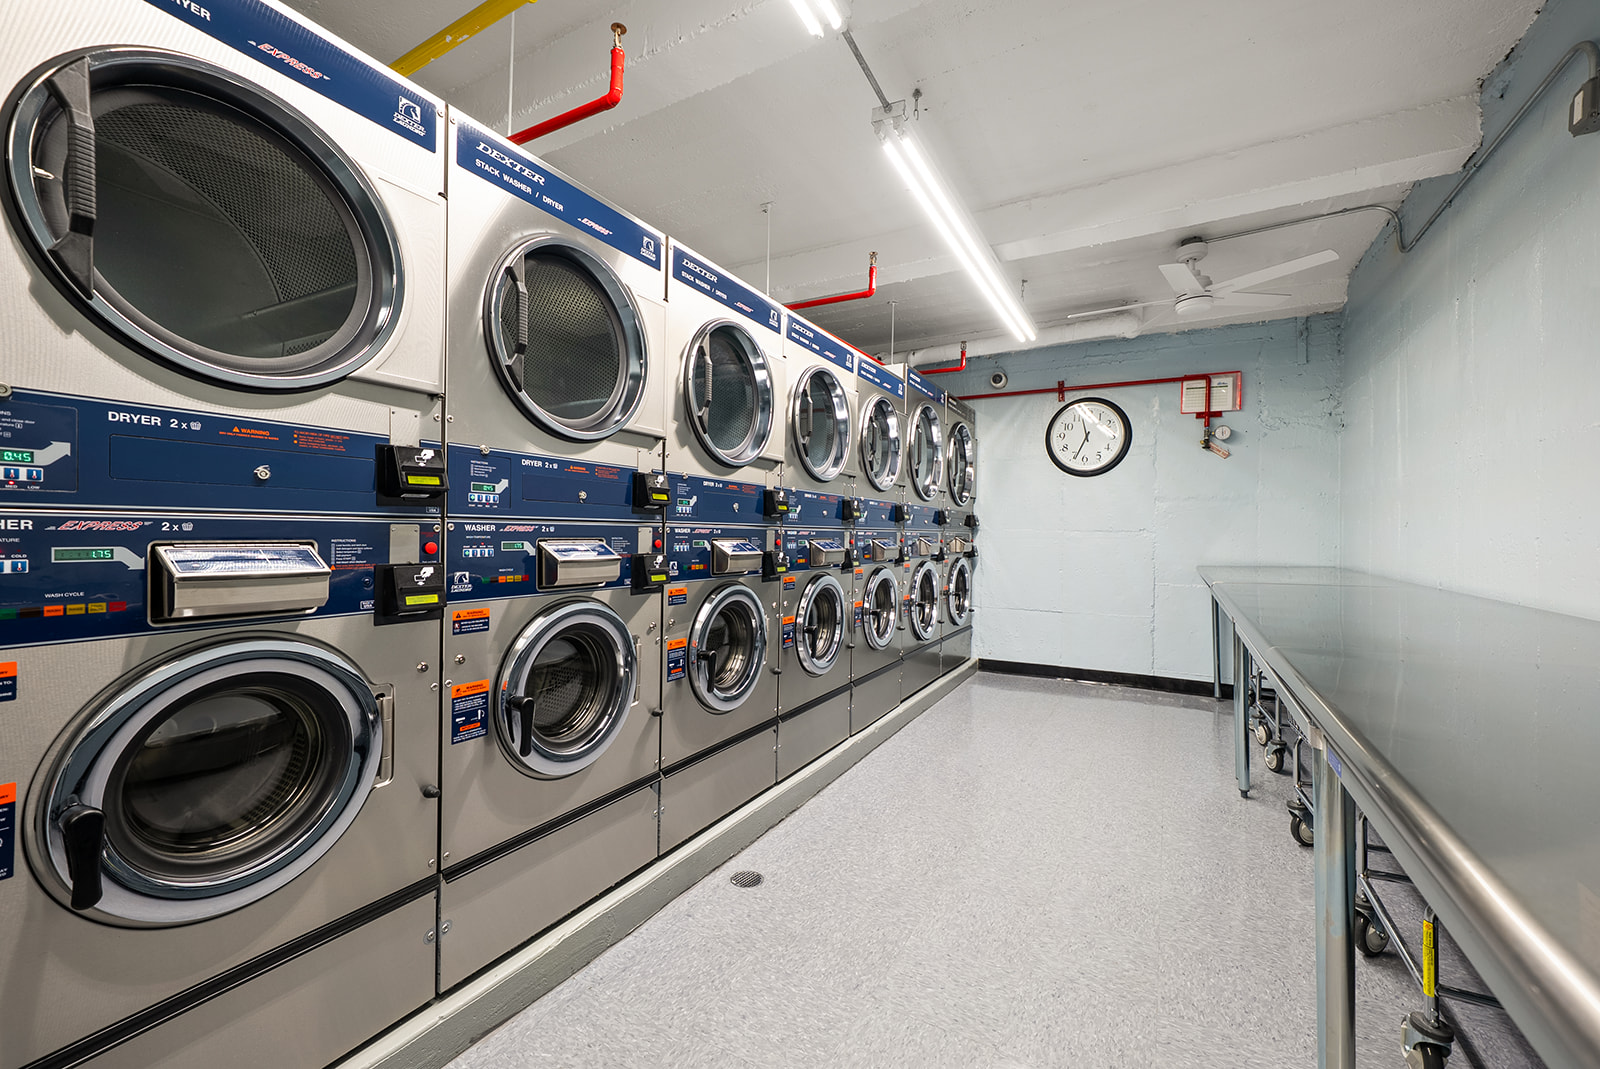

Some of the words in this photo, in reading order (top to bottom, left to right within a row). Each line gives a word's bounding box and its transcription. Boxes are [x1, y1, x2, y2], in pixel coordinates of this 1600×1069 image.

[257, 43, 323, 79] EXPRESS
[475, 142, 546, 186] DEXTER
[475, 159, 501, 178] STACK
[502, 173, 532, 195] WASHER
[542, 195, 564, 212] DRYER
[682, 258, 718, 284] DEXTER
[107, 411, 162, 426] DRYER
[169, 418, 179, 428] 2
[1064, 422, 1074, 431] 10
[241, 428, 270, 436] WARNING
[1059, 432, 1066, 440] 9
[1061, 443, 1069, 452] 8
[1104, 443, 1111, 451] 4
[3, 451, 32, 462] 0.45
[1081, 454, 1089, 463] 6
[1096, 451, 1102, 462] 5
[521, 459, 543, 468] DRYER
[57, 520, 144, 531] EXPRESS
[161, 521, 170, 531] 2
[172, 523, 180, 531] x
[464, 524, 496, 532] WASHER
